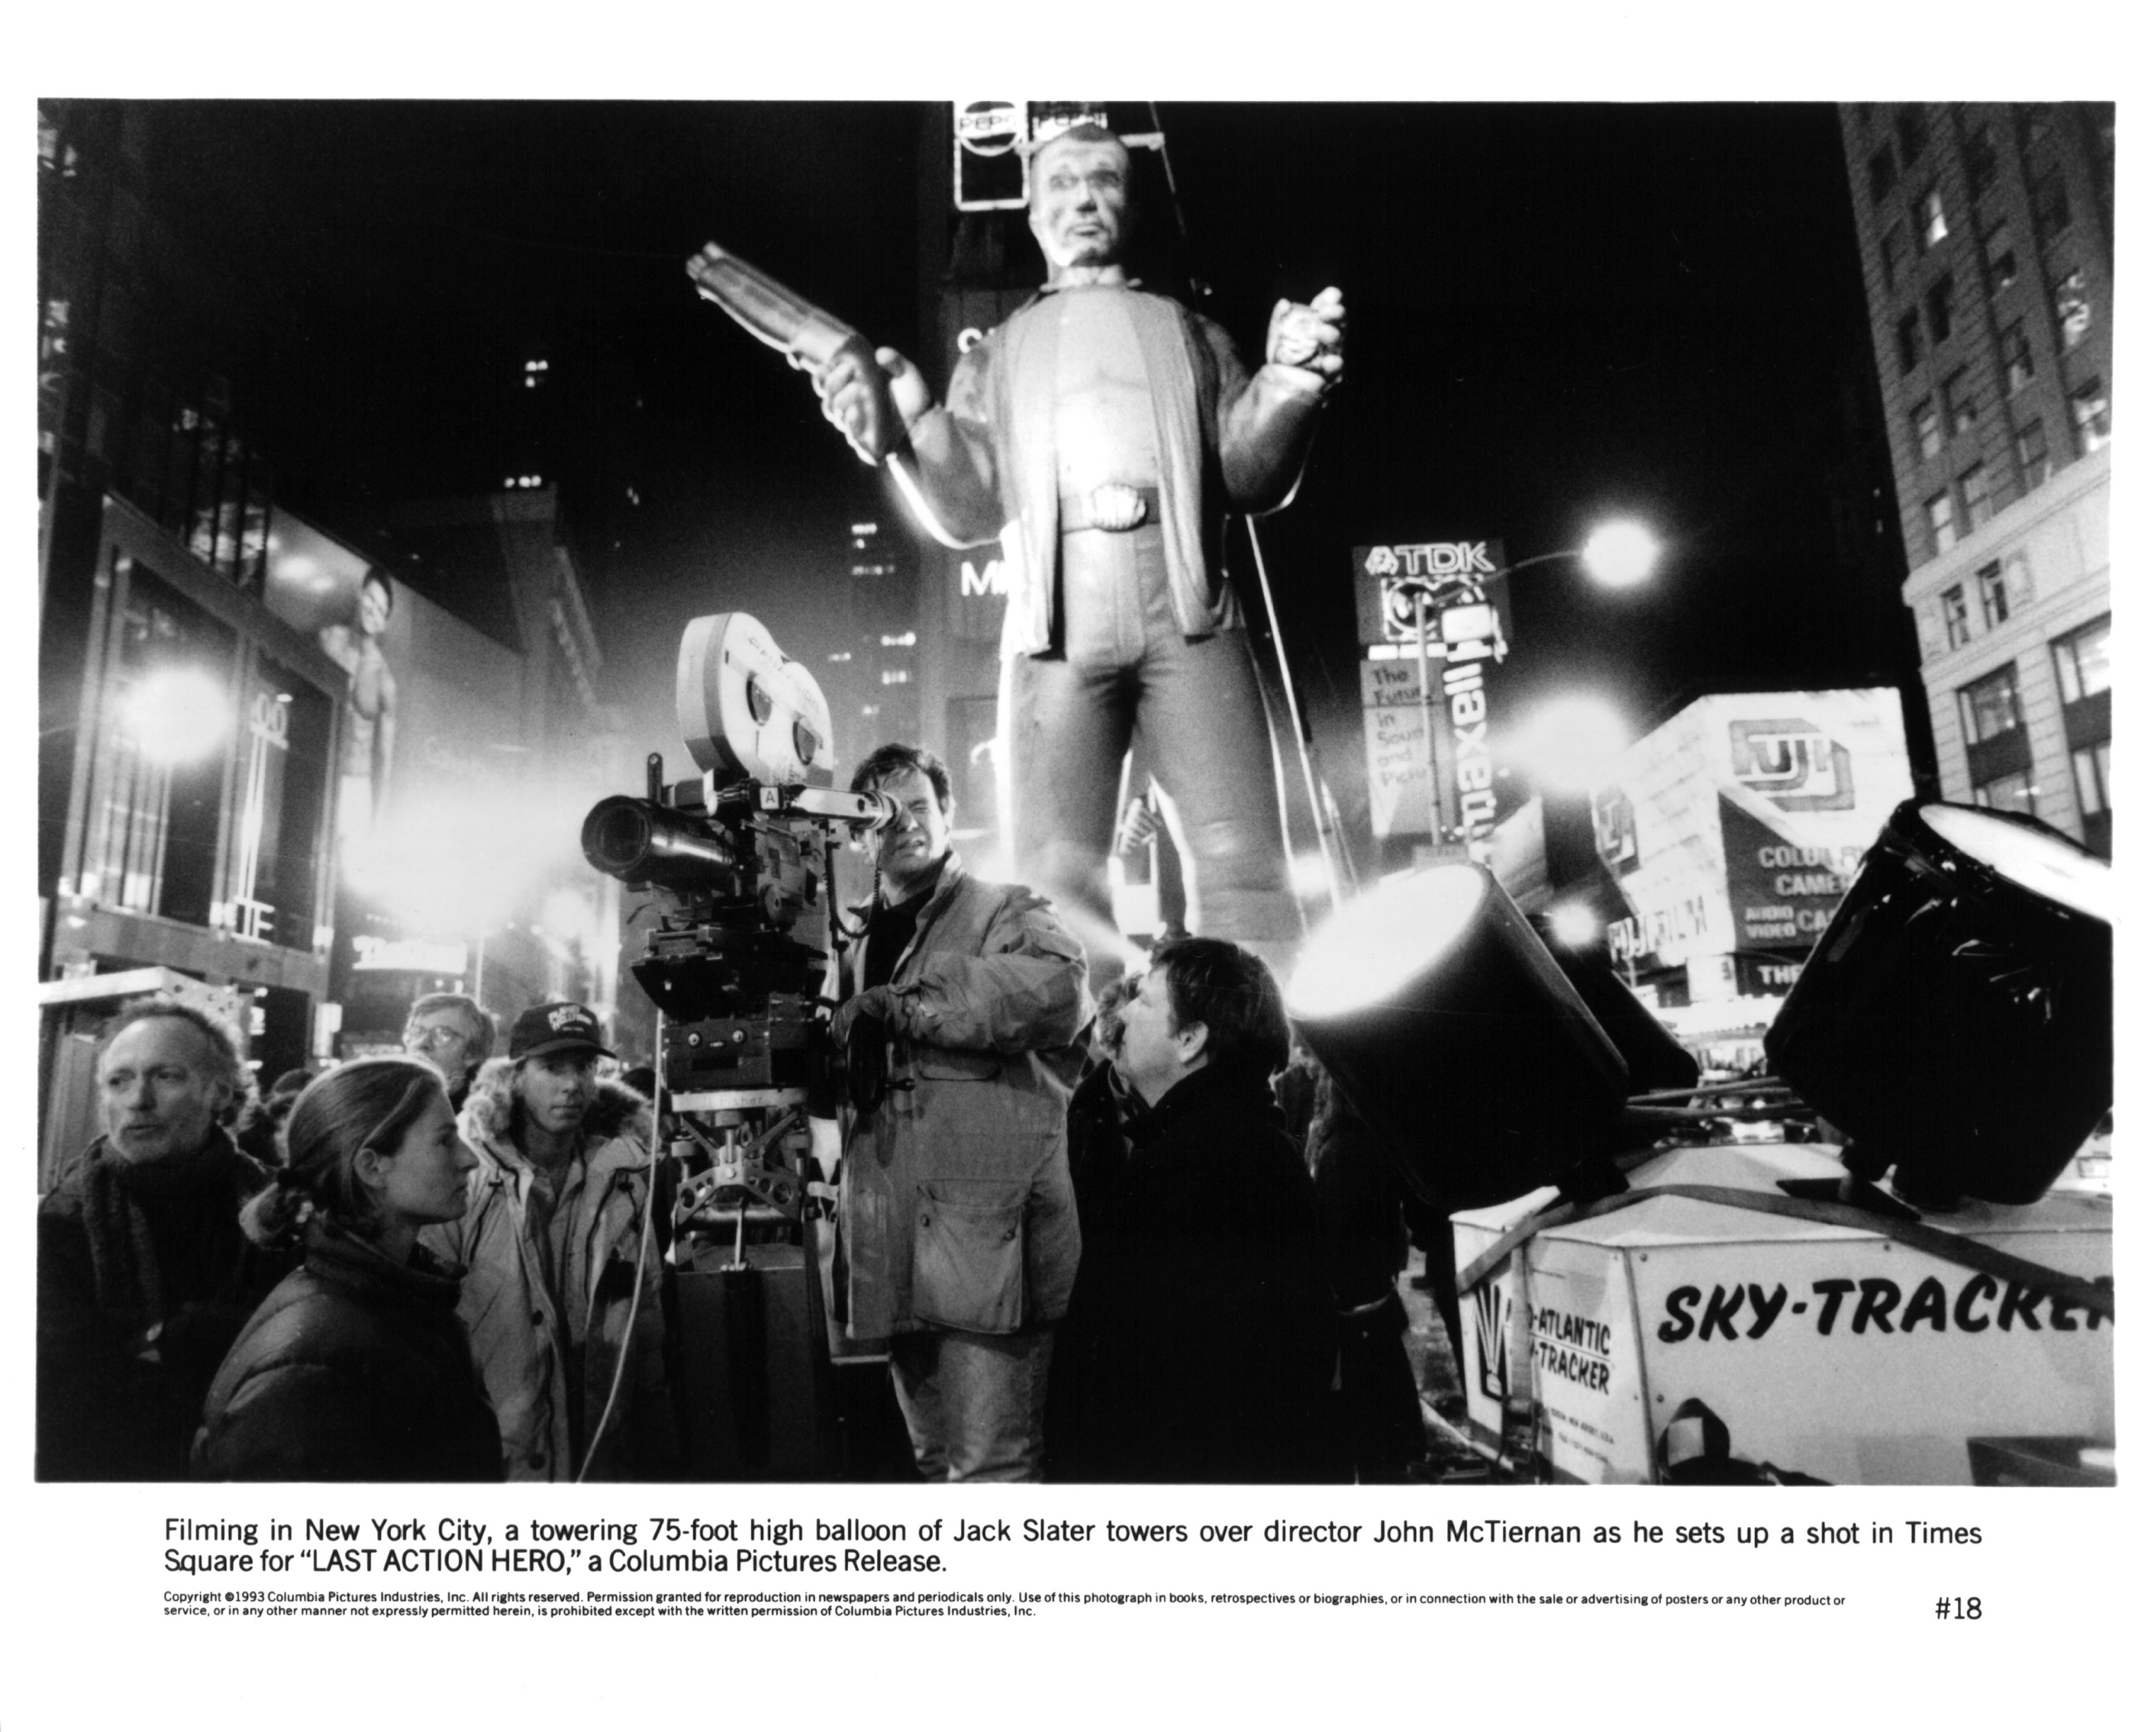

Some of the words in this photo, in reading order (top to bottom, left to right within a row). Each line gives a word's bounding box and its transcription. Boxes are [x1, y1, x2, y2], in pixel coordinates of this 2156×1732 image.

[1394, 542, 1496, 575] TDK
[1372, 667, 1409, 685] The
[765, 790, 776, 803] A
[1746, 905, 1794, 921] AUDIO
[1746, 922, 1796, 938] VIDEO
